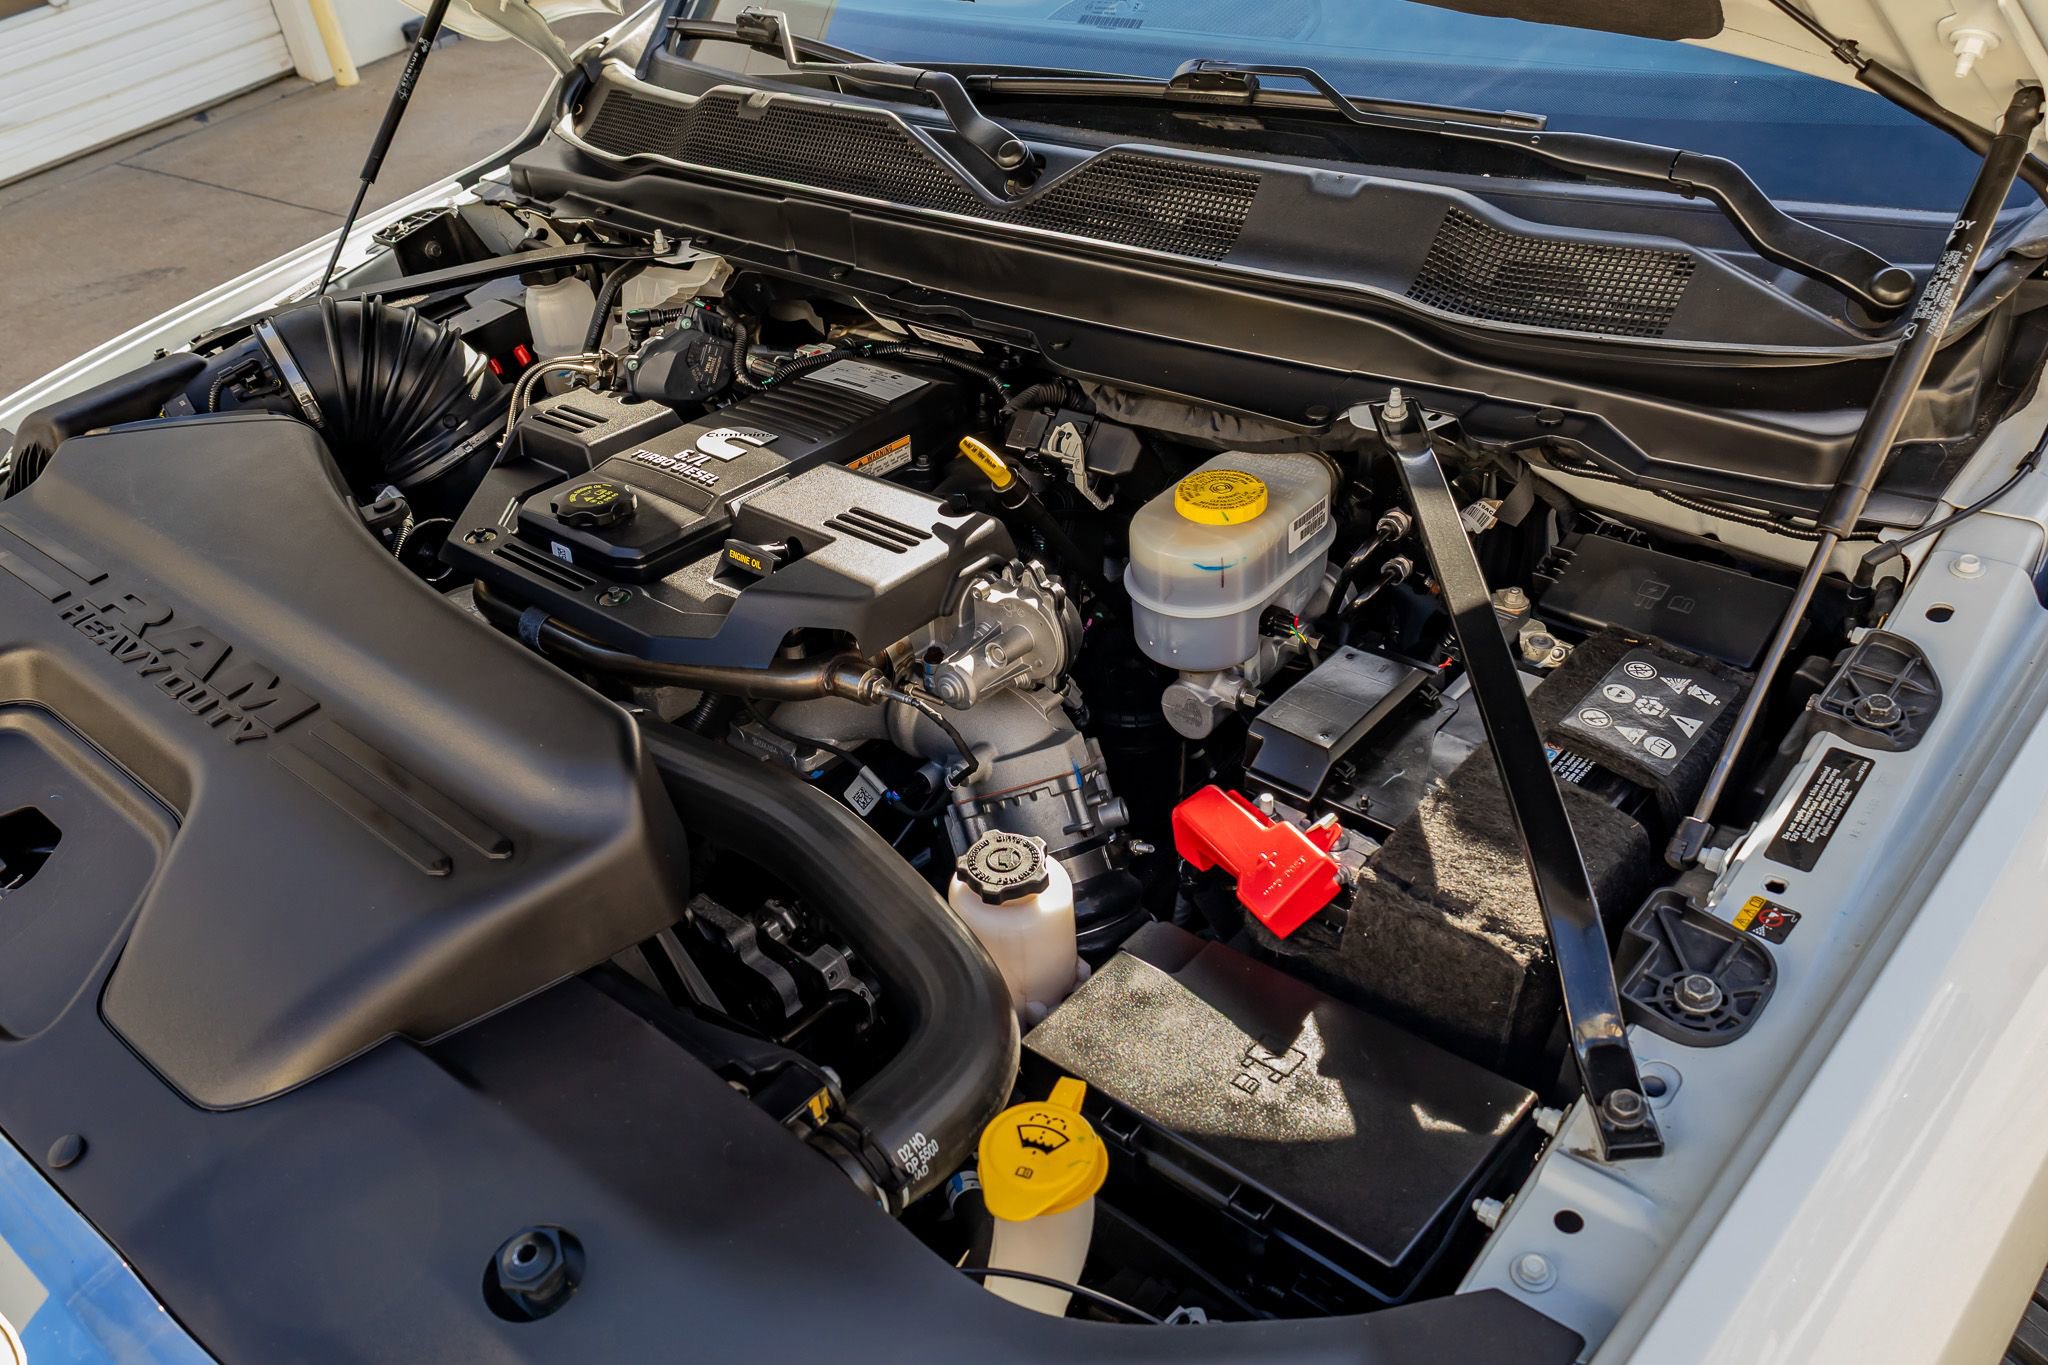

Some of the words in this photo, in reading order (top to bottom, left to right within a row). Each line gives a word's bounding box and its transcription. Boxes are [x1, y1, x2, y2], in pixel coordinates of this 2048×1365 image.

[674, 449, 712, 467] 6.7L
[866, 444, 893, 462] WARNING
[631, 449, 674, 470] TURBO
[671, 461, 720, 487] DIESEL
[729, 549, 750, 565] ENGINE
[751, 558, 761, 570] OIL
[57, 603, 173, 678] HEAVY
[153, 671, 268, 745] DUTY
[82, 592, 321, 734] RAM
[1815, 765, 1831, 784] nominal
[1801, 795, 1813, 808] more
[1807, 783, 1820, 796] than
[1789, 830, 1801, 842] 12V
[1800, 800, 1819, 824] electrical
[1814, 783, 1830, 801] system
[1825, 767, 1840, 784] during
[1792, 808, 1807, 823] apply
[1807, 825, 1823, 843] Engine
[1817, 815, 1828, 825] and
[1823, 795, 1841, 816] starting
[1835, 777, 1851, 796] system
[1786, 821, 1797, 831] not
[1800, 816, 1819, 839] charging
[1817, 797, 1830, 811] jump
[1819, 819, 1834, 836] failure
[1829, 806, 1842, 819] could
[1781, 831, 1792, 840] Do
[897, 1144, 914, 1163] D2
[909, 1132, 927, 1153] HO
[905, 1157, 919, 1174] DP
[919, 1139, 939, 1164] 5500
